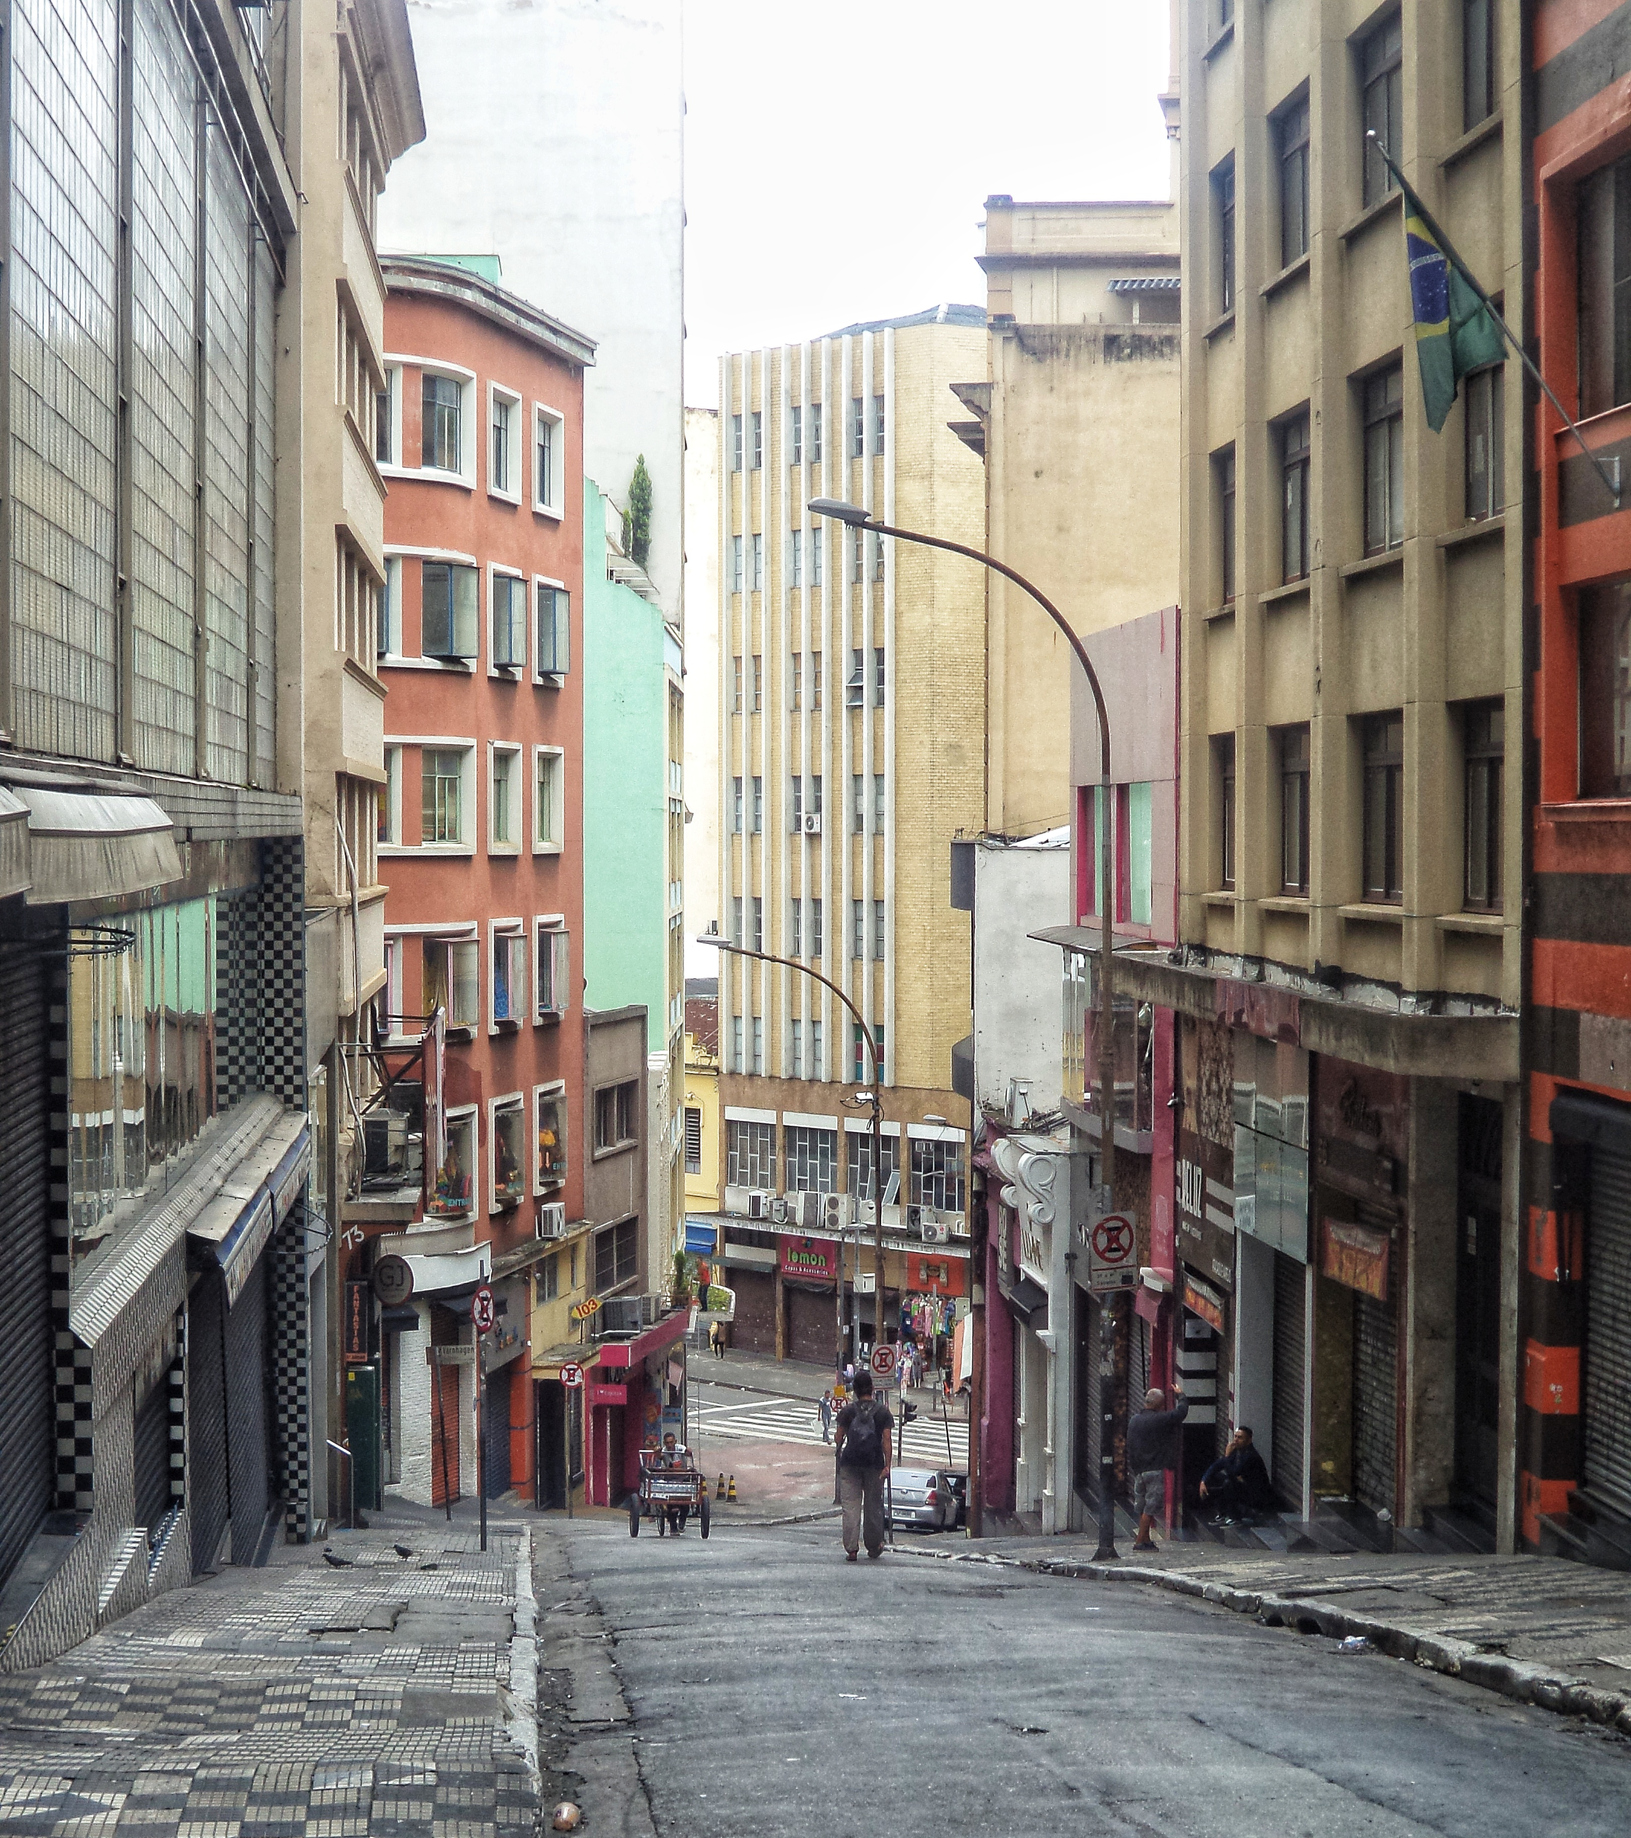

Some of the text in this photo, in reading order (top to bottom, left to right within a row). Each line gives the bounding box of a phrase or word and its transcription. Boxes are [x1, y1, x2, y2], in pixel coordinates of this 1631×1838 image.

[342, 1224, 365, 1250] 73
[352, 1285, 360, 1352] FANTASIAS
[575, 1298, 598, 1318] 103
